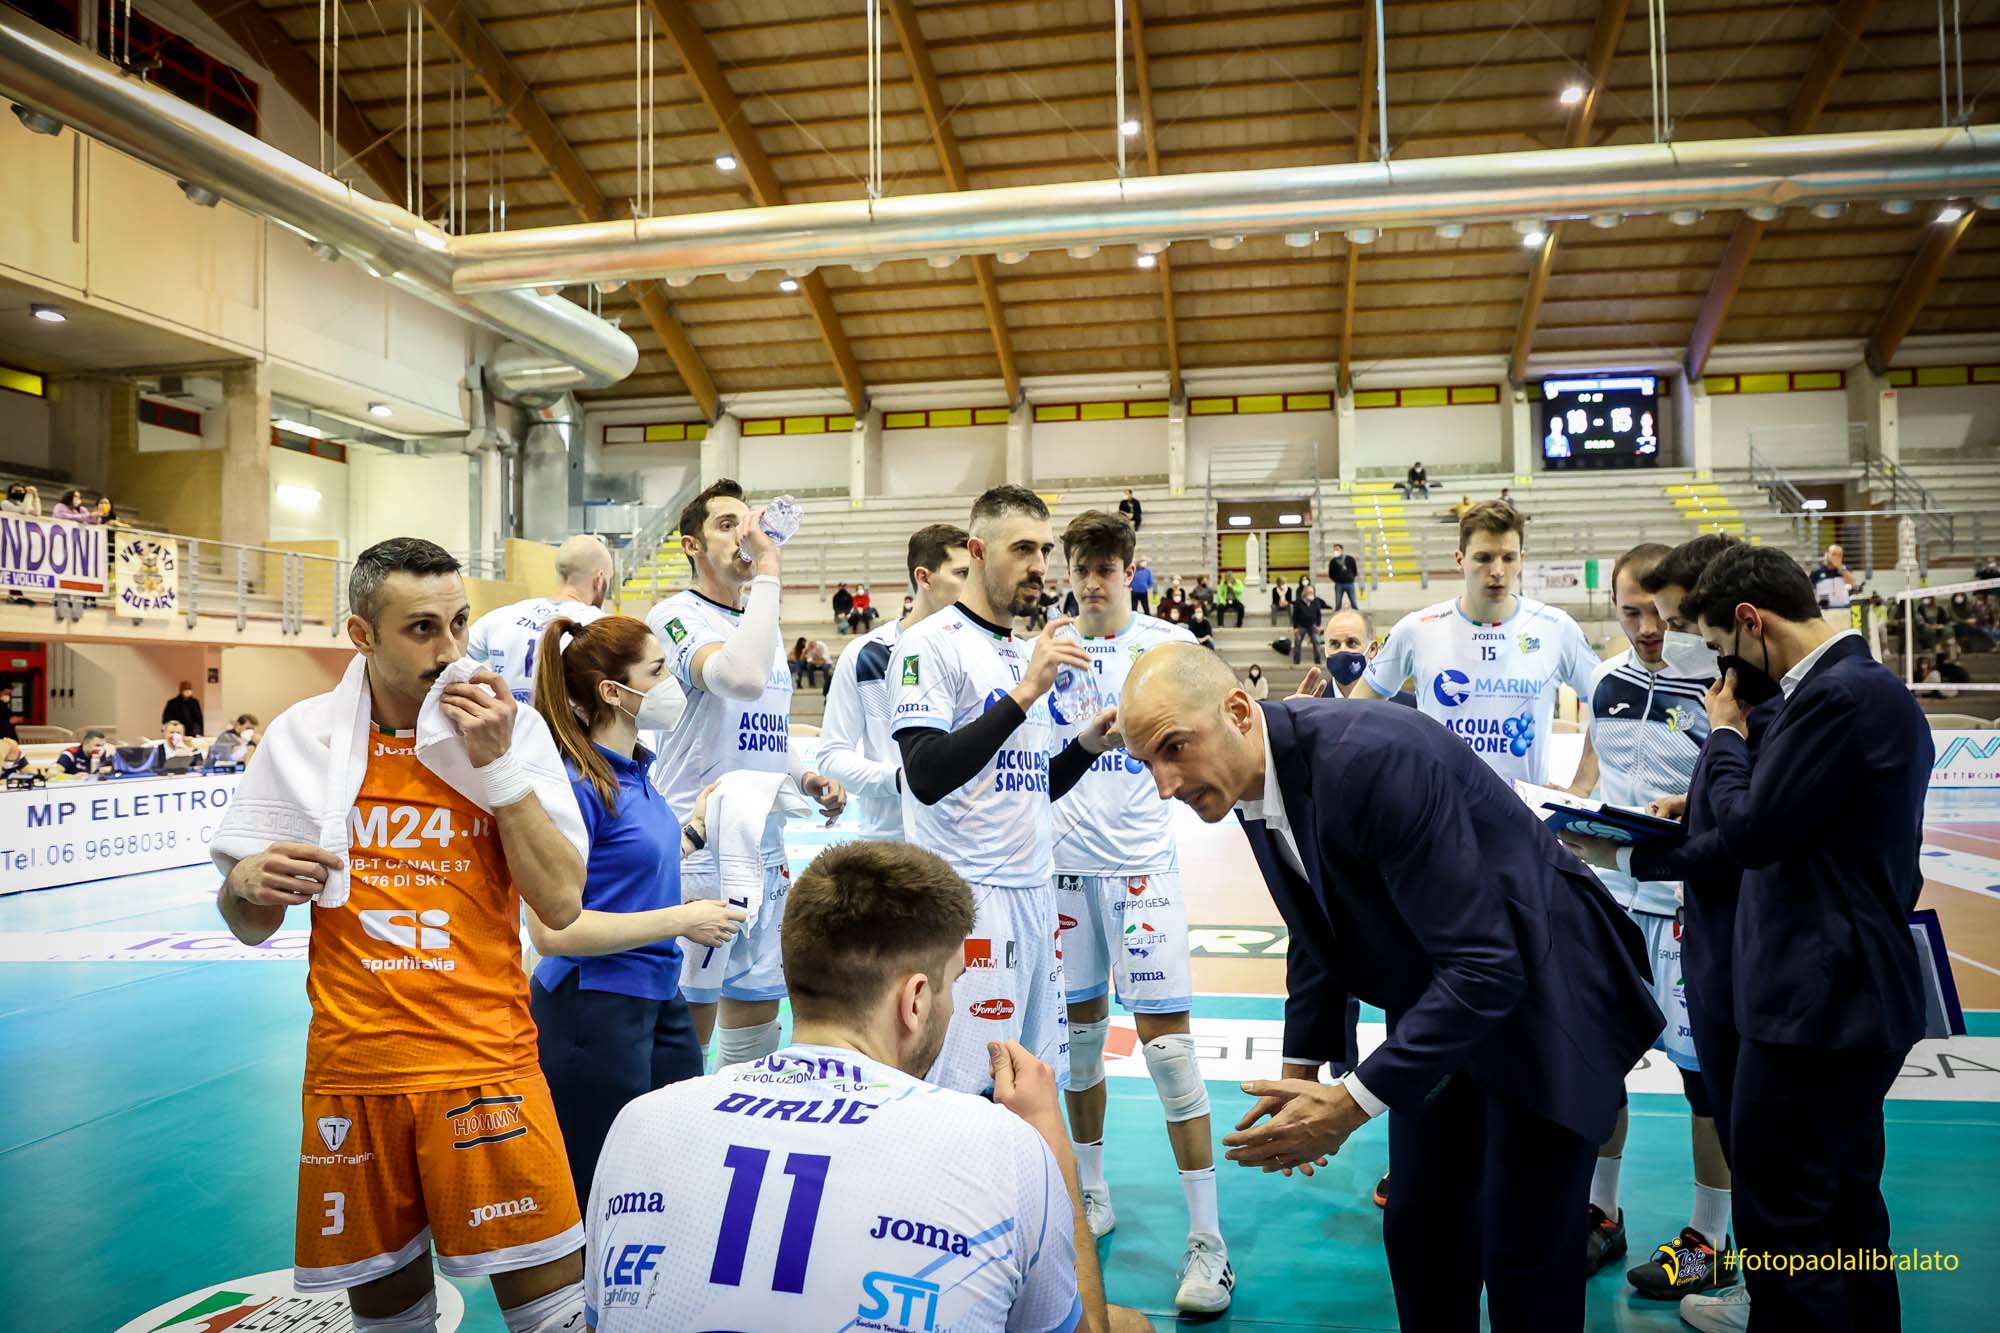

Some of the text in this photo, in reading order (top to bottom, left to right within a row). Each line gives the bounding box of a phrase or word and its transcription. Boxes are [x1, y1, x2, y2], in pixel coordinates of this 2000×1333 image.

[1481, 647, 1497, 661] 15
[1475, 678, 1542, 694] MARINI
[739, 711, 784, 733] ACQUA
[27, 787, 236, 828] MP ELETTRO
[394, 874, 410, 887] DI
[455, 860, 471, 873] 37
[453, 1106, 521, 1136] HOMMY
[719, 1092, 880, 1125] DIRLIC
[321, 1191, 346, 1236] 3
[708, 1144, 831, 1295] 11
[604, 1244, 667, 1288] LEF
[858, 1270, 941, 1332] STI
